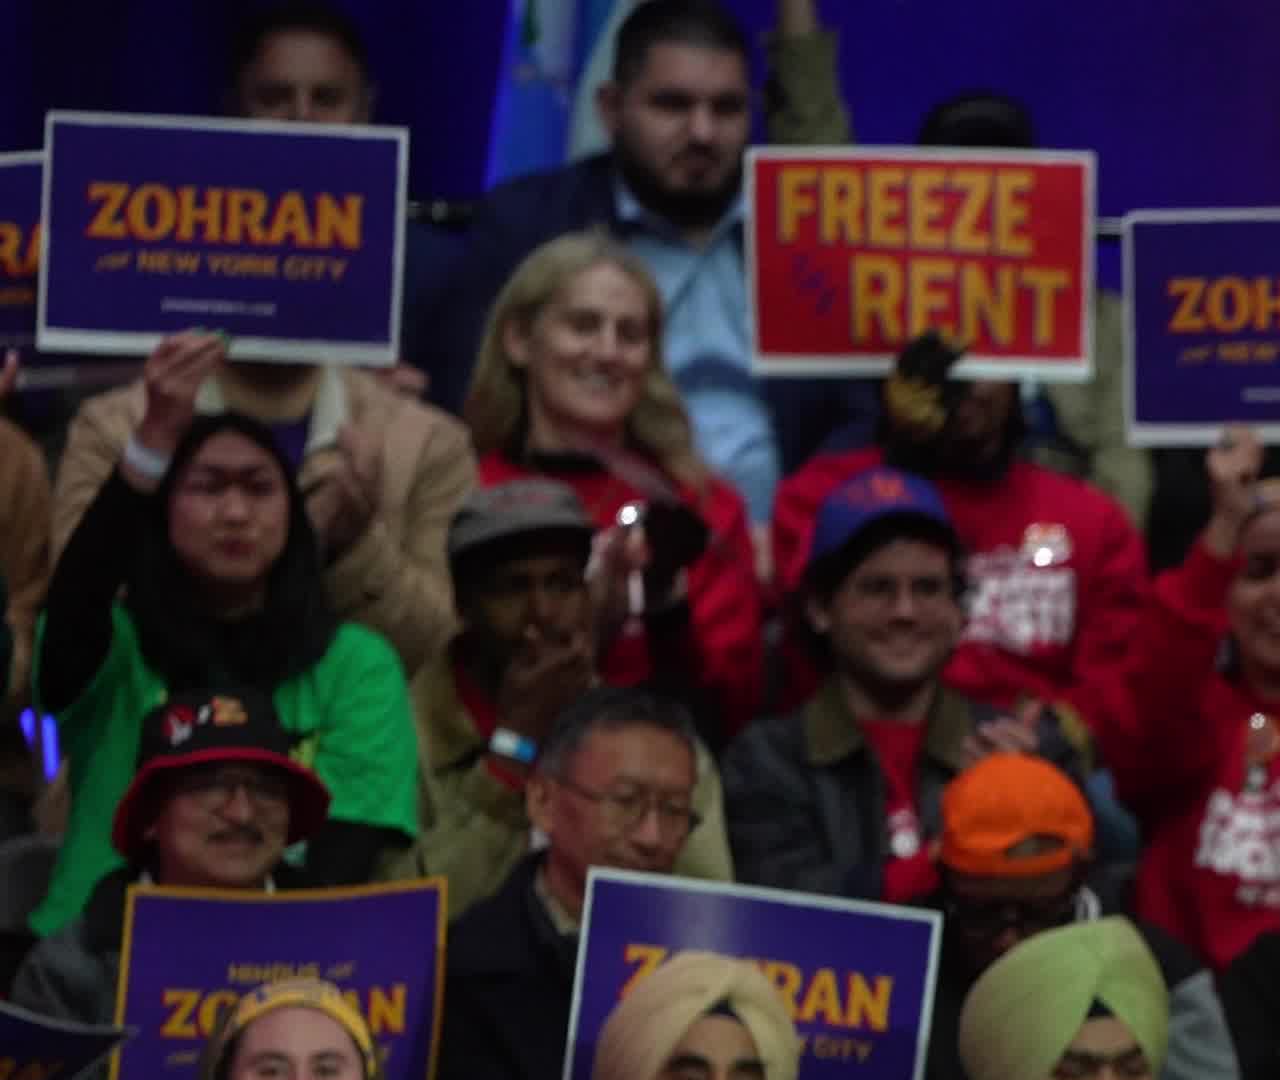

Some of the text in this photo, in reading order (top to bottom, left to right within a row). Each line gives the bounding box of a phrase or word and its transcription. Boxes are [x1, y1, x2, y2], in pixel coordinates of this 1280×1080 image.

[86, 181, 365, 251] ZOHRAN
[776, 166, 1033, 257] FREEZE
[849, 253, 1070, 348] RENT
